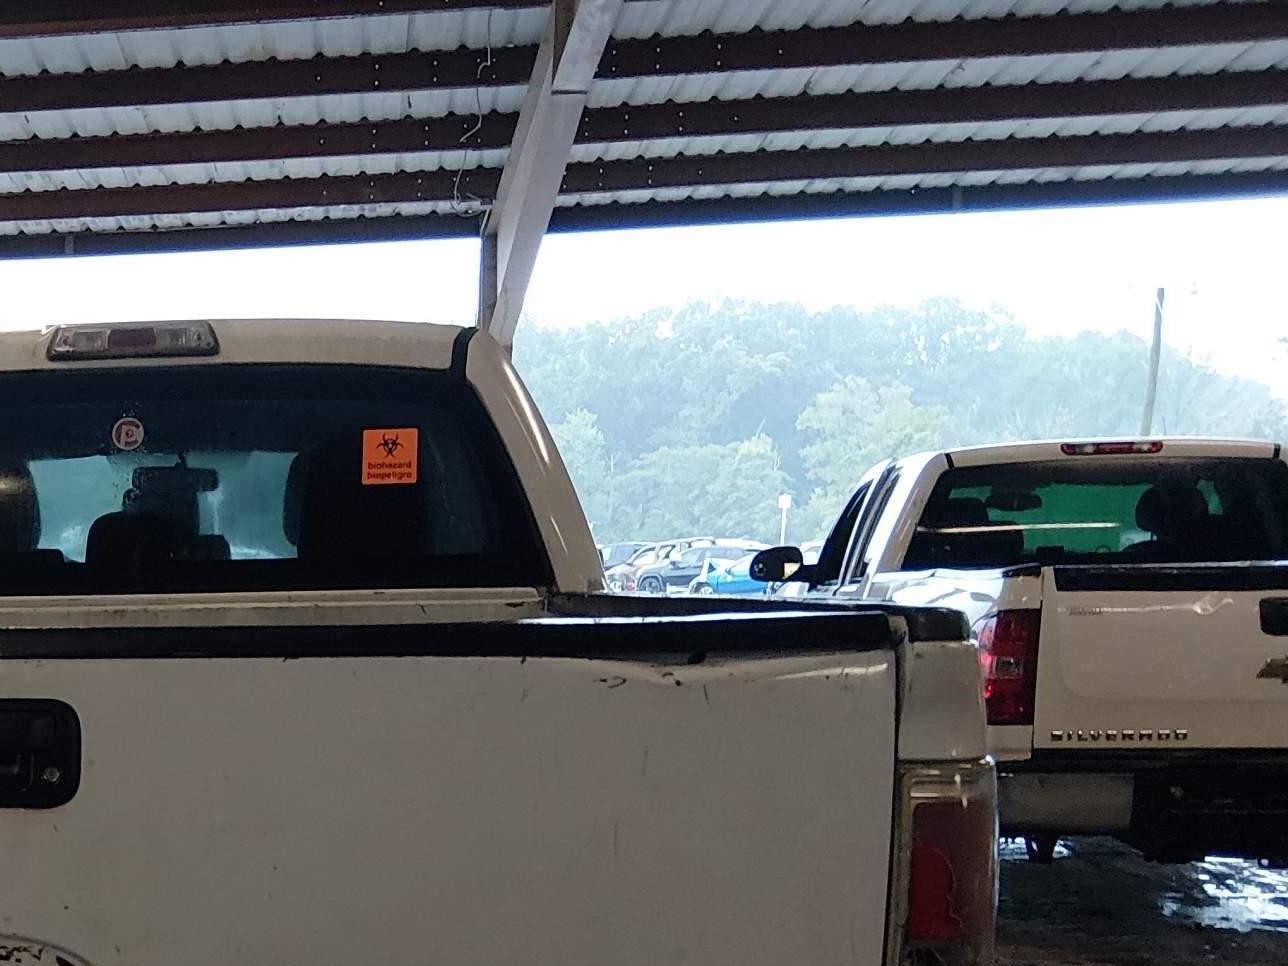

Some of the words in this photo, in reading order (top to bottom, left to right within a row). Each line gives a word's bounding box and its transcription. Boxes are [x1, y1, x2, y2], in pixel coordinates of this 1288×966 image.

[367, 460, 412, 470] biohazard
[367, 471, 413, 481] biopeligro
[1050, 729, 1188, 742] SILVERADO
